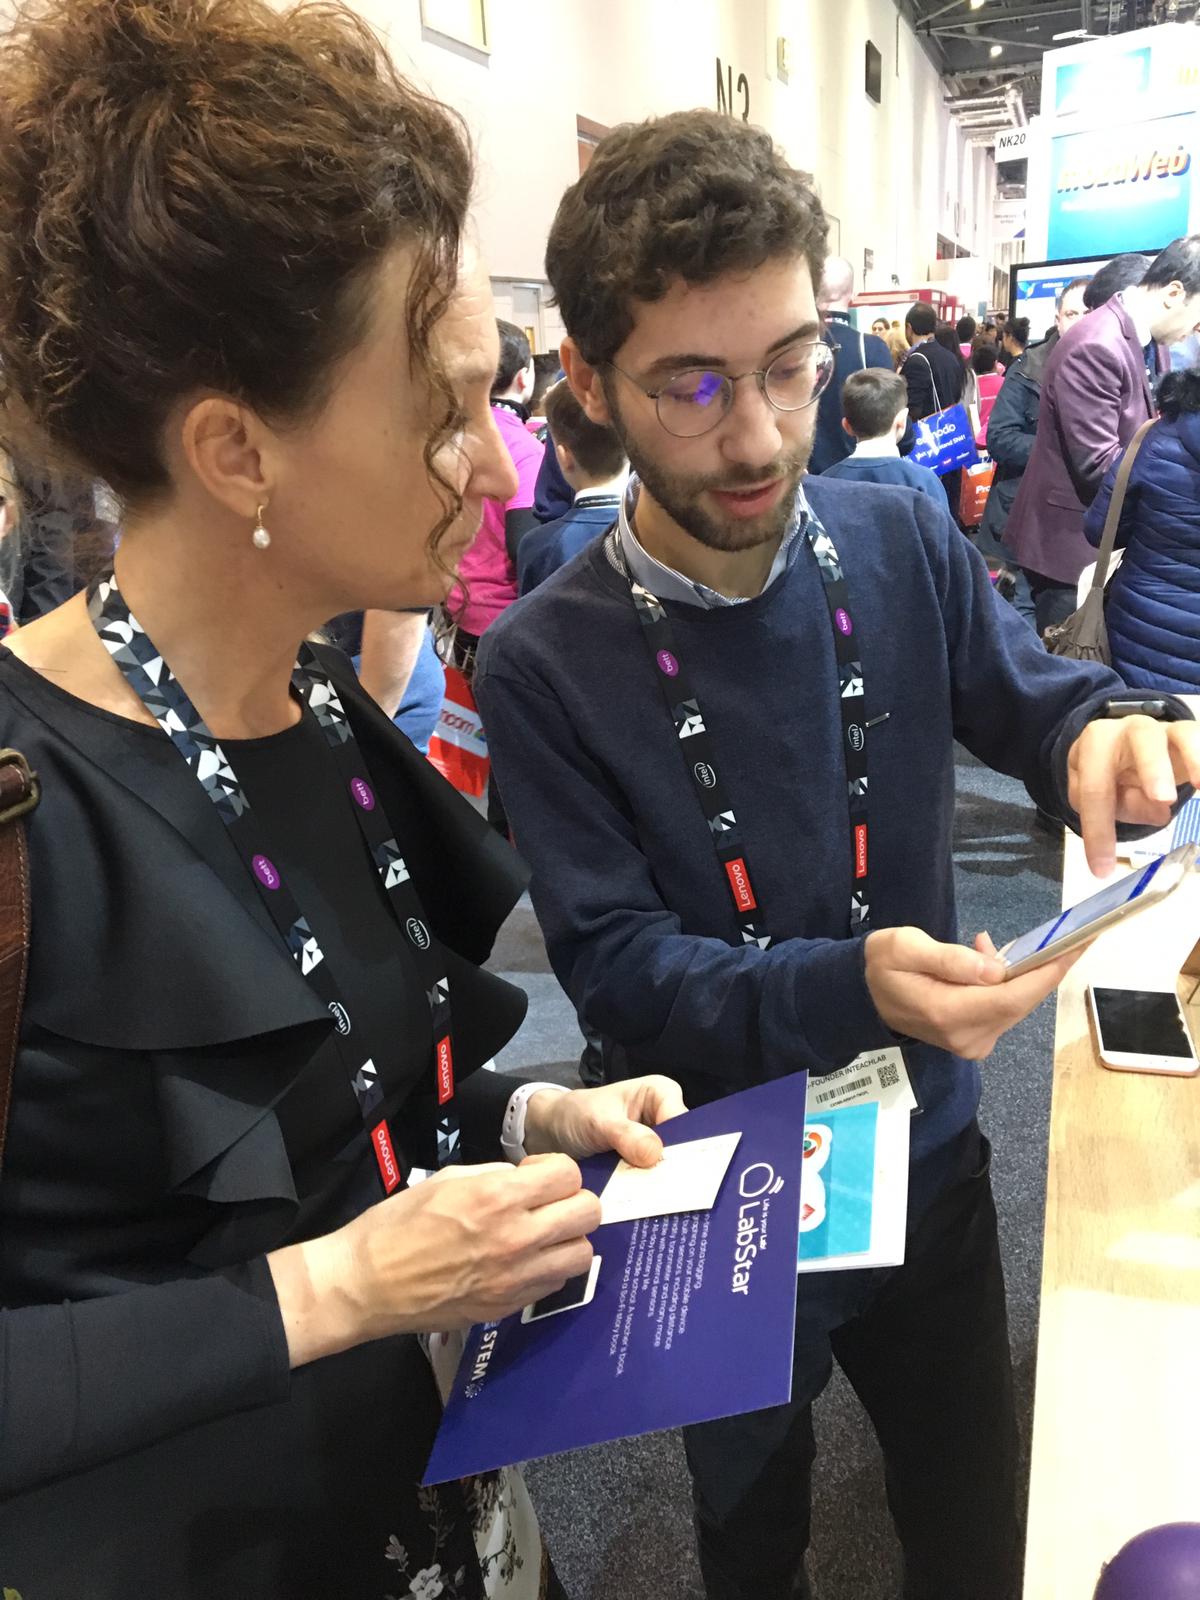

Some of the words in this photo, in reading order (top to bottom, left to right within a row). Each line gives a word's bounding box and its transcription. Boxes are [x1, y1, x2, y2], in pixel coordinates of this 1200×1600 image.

[999, 132, 1026, 149] NK20
[840, 612, 848, 631] bett
[662, 653, 673, 673] bett
[851, 728, 860, 749] intel
[698, 765, 710, 787] intel
[356, 782, 370, 806] bett
[258, 859, 275, 885] bett
[732, 864, 751, 907] Lenovo
[409, 923, 425, 948] intel
[440, 1044, 451, 1098] Lenovo
[845, 1054, 887, 1075] INTEACHLAB
[377, 1129, 398, 1186] Lenovo
[731, 1201, 761, 1296] LabStar
[471, 1330, 498, 1381] STEM
